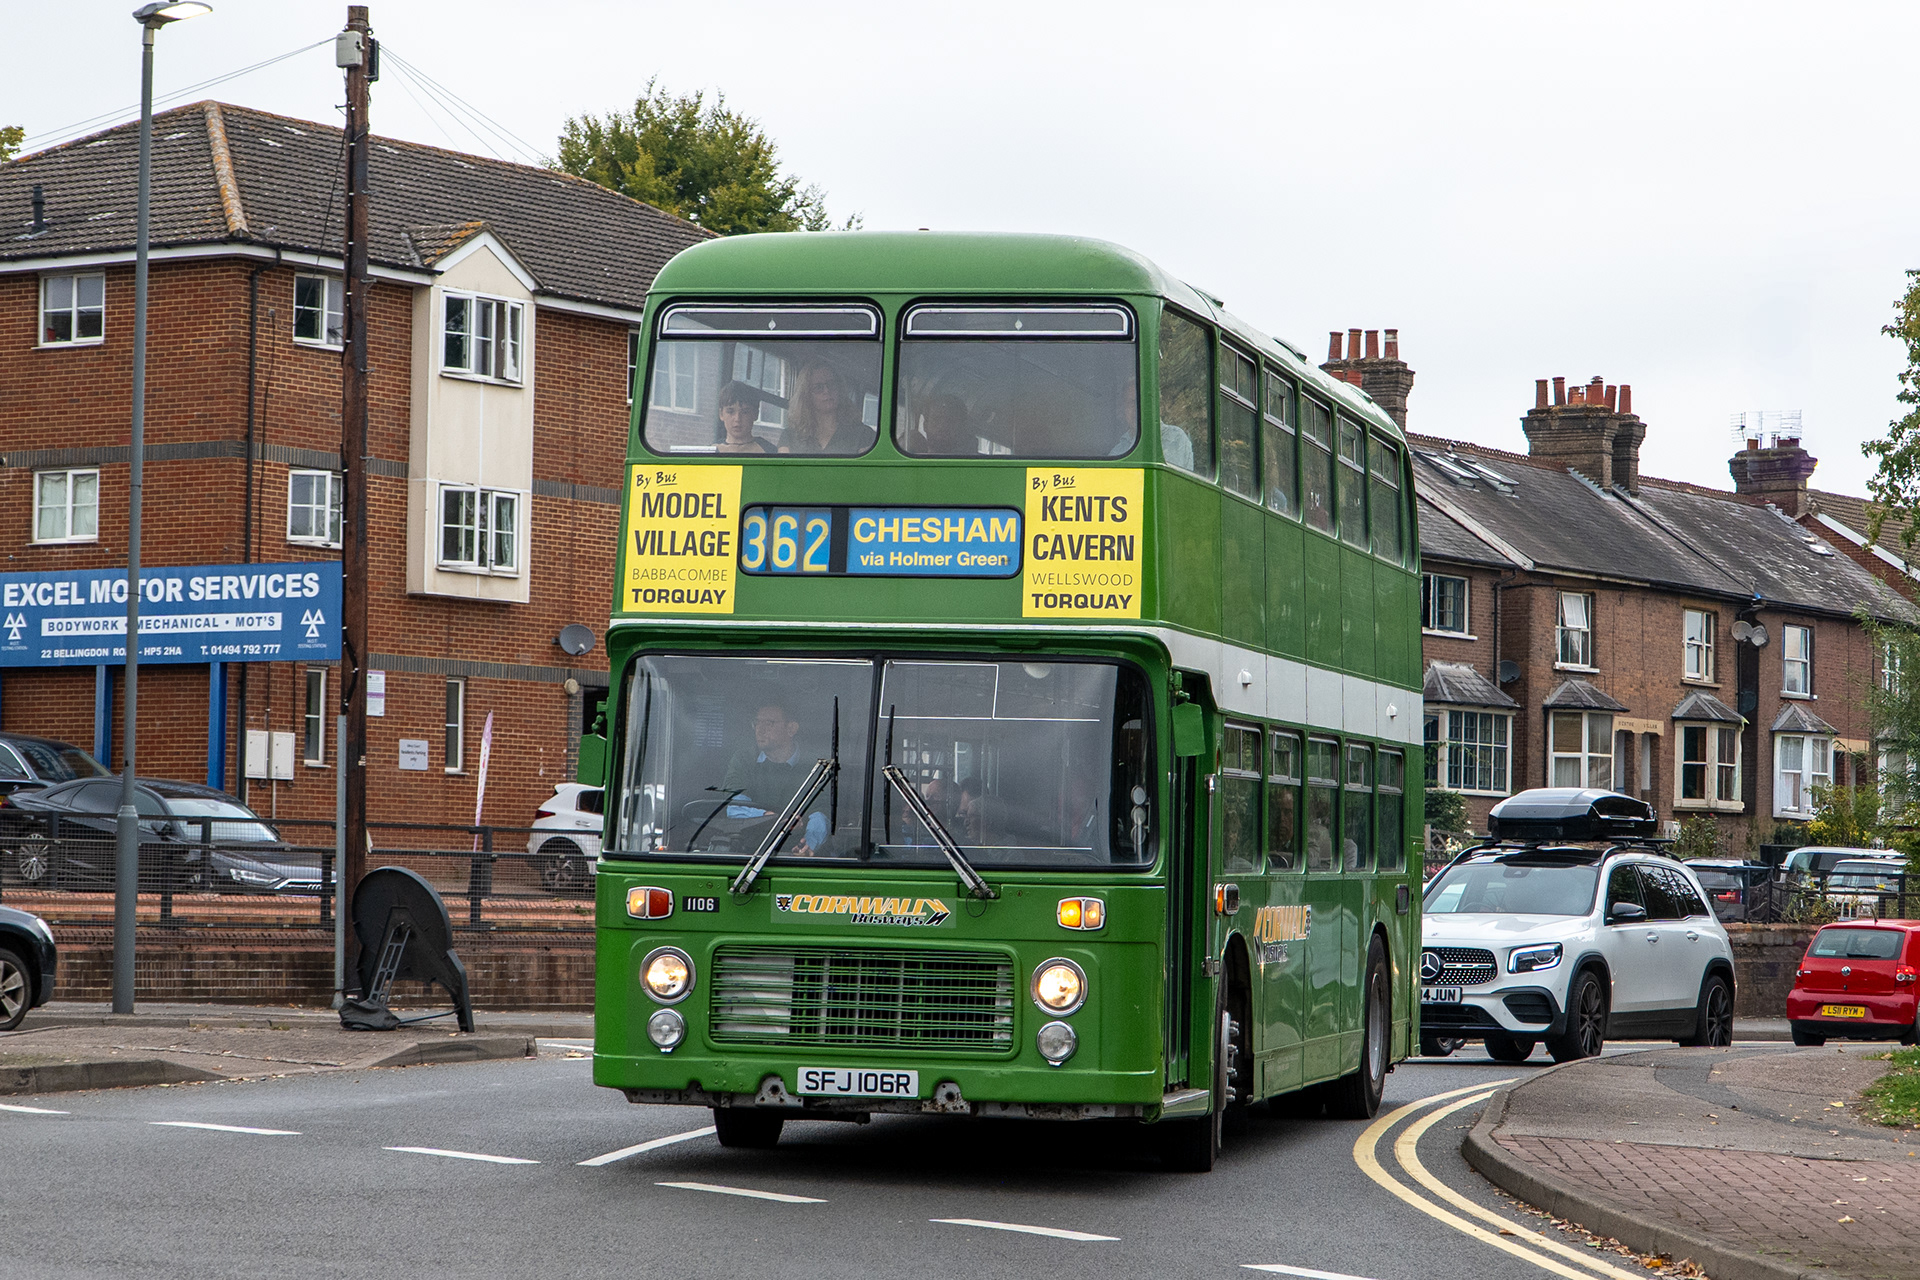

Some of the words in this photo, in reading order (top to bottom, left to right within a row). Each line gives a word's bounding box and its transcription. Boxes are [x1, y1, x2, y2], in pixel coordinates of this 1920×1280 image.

[636, 474, 651, 489] By
[656, 471, 677, 484] Bus
[1032, 477, 1048, 492] By
[1053, 474, 1075, 486] Bus
[641, 492, 727, 519] MODEL
[1041, 495, 1128, 522] KENTS
[853, 517, 1017, 543] CHESHAM
[634, 530, 730, 557] VILLAGE
[741, 515, 829, 572] 362
[1033, 534, 1135, 561] CAVERN
[860, 552, 884, 566] via
[889, 552, 952, 566] Holmer
[957, 551, 1008, 566] Green
[632, 568, 728, 581] BABBACOMBE
[1032, 573, 1133, 586] WELLSWOOD
[3, 581, 85, 607] EXCEL
[90, 578, 183, 604] MOTOR
[188, 572, 320, 601] SERVICES
[631, 588, 727, 604] TORQUAY
[1031, 593, 1133, 609] TORQUAY
[48, 620, 118, 632] BODYWORK
[235, 616, 275, 627] MOT'S
[41, 649, 52, 658] 22
[53, 648, 109, 658] BELLINGDON
[144, 647, 162, 656] HP5
[163, 646, 182, 655] 2HA
[200, 645, 208, 655] T.
[210, 645, 241, 655] 01494
[243, 644, 260, 655] 792
[262, 644, 281, 654] 777
[687, 897, 714, 911] 1106
[791, 894, 927, 916] CORNWALL
[851, 913, 924, 927] Busways
[805, 1070, 851, 1092] SFJ
[858, 1072, 910, 1094] 106R
